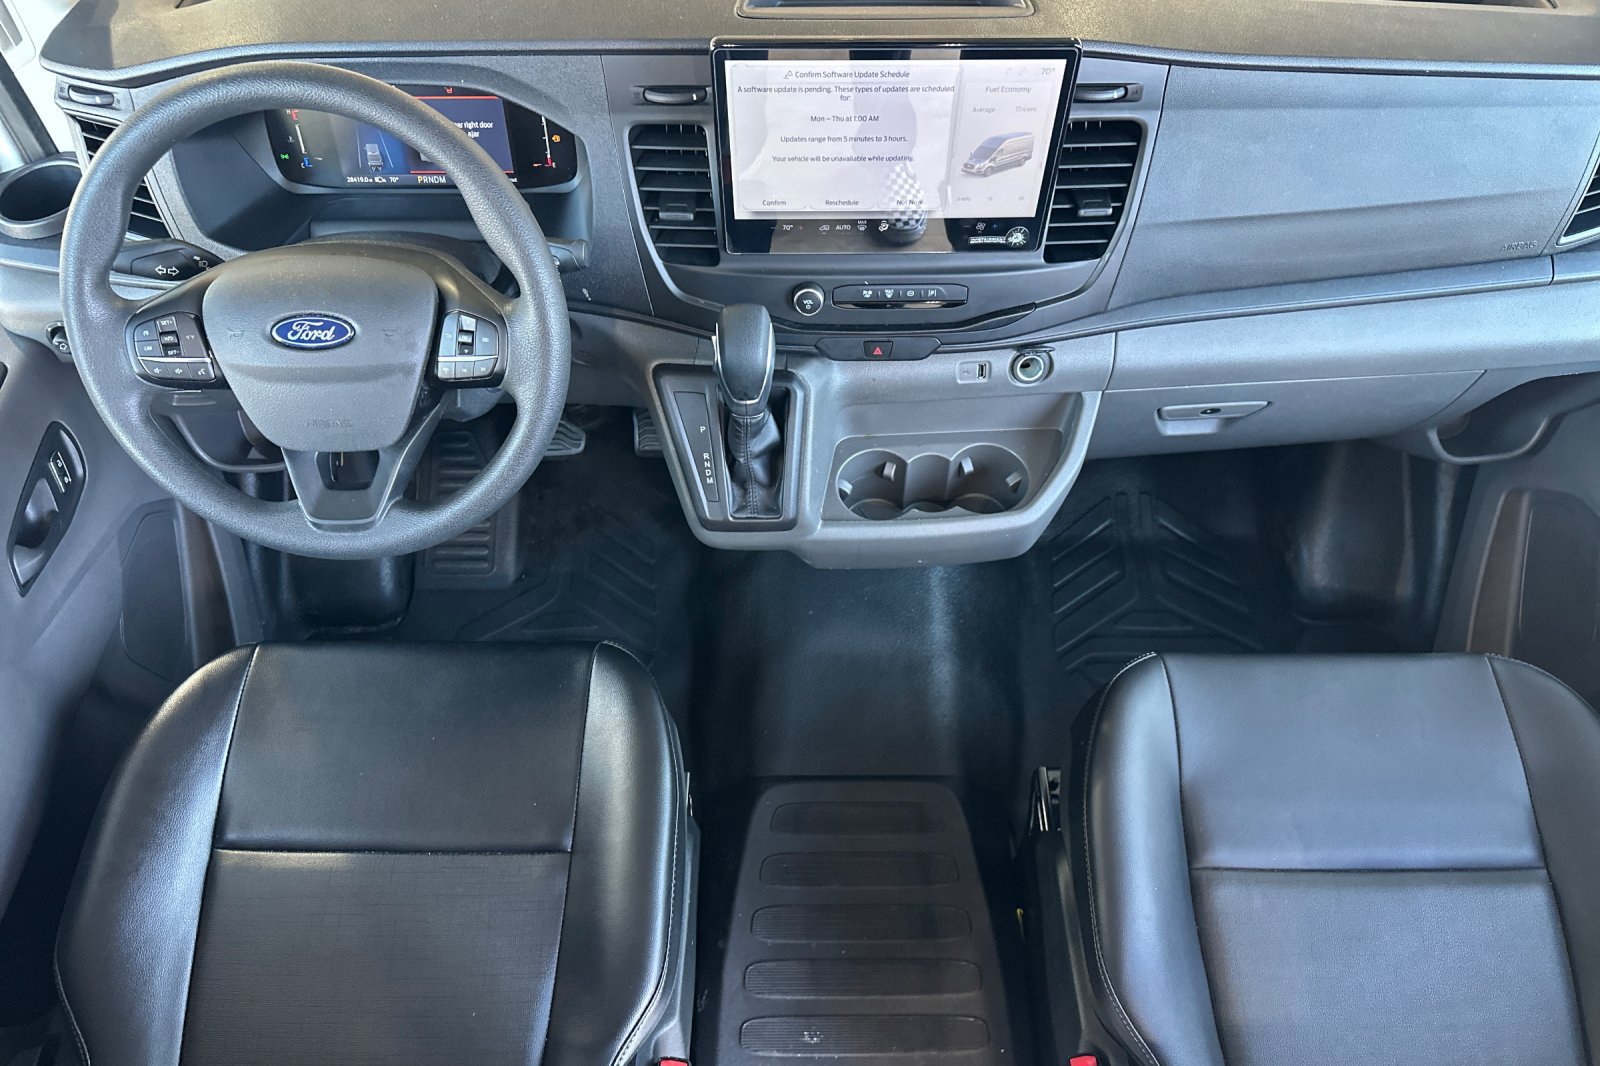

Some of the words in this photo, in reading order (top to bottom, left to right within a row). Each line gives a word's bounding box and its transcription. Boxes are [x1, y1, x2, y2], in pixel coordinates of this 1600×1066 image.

[795, 71, 821, 79] Confirm
[823, 71, 853, 79] Software
[854, 71, 878, 79] Update
[774, 86, 797, 94] update
[804, 86, 833, 94] pending.
[855, 86, 873, 94] types
[882, 86, 909, 94] updates
[922, 85, 955, 93] scheduled
[1000, 86, 1032, 94] Economy
[464, 121, 478, 129] right
[417, 175, 447, 184] PRNDM
[287, 320, 335, 341] Ford
[703, 452, 710, 460] R
